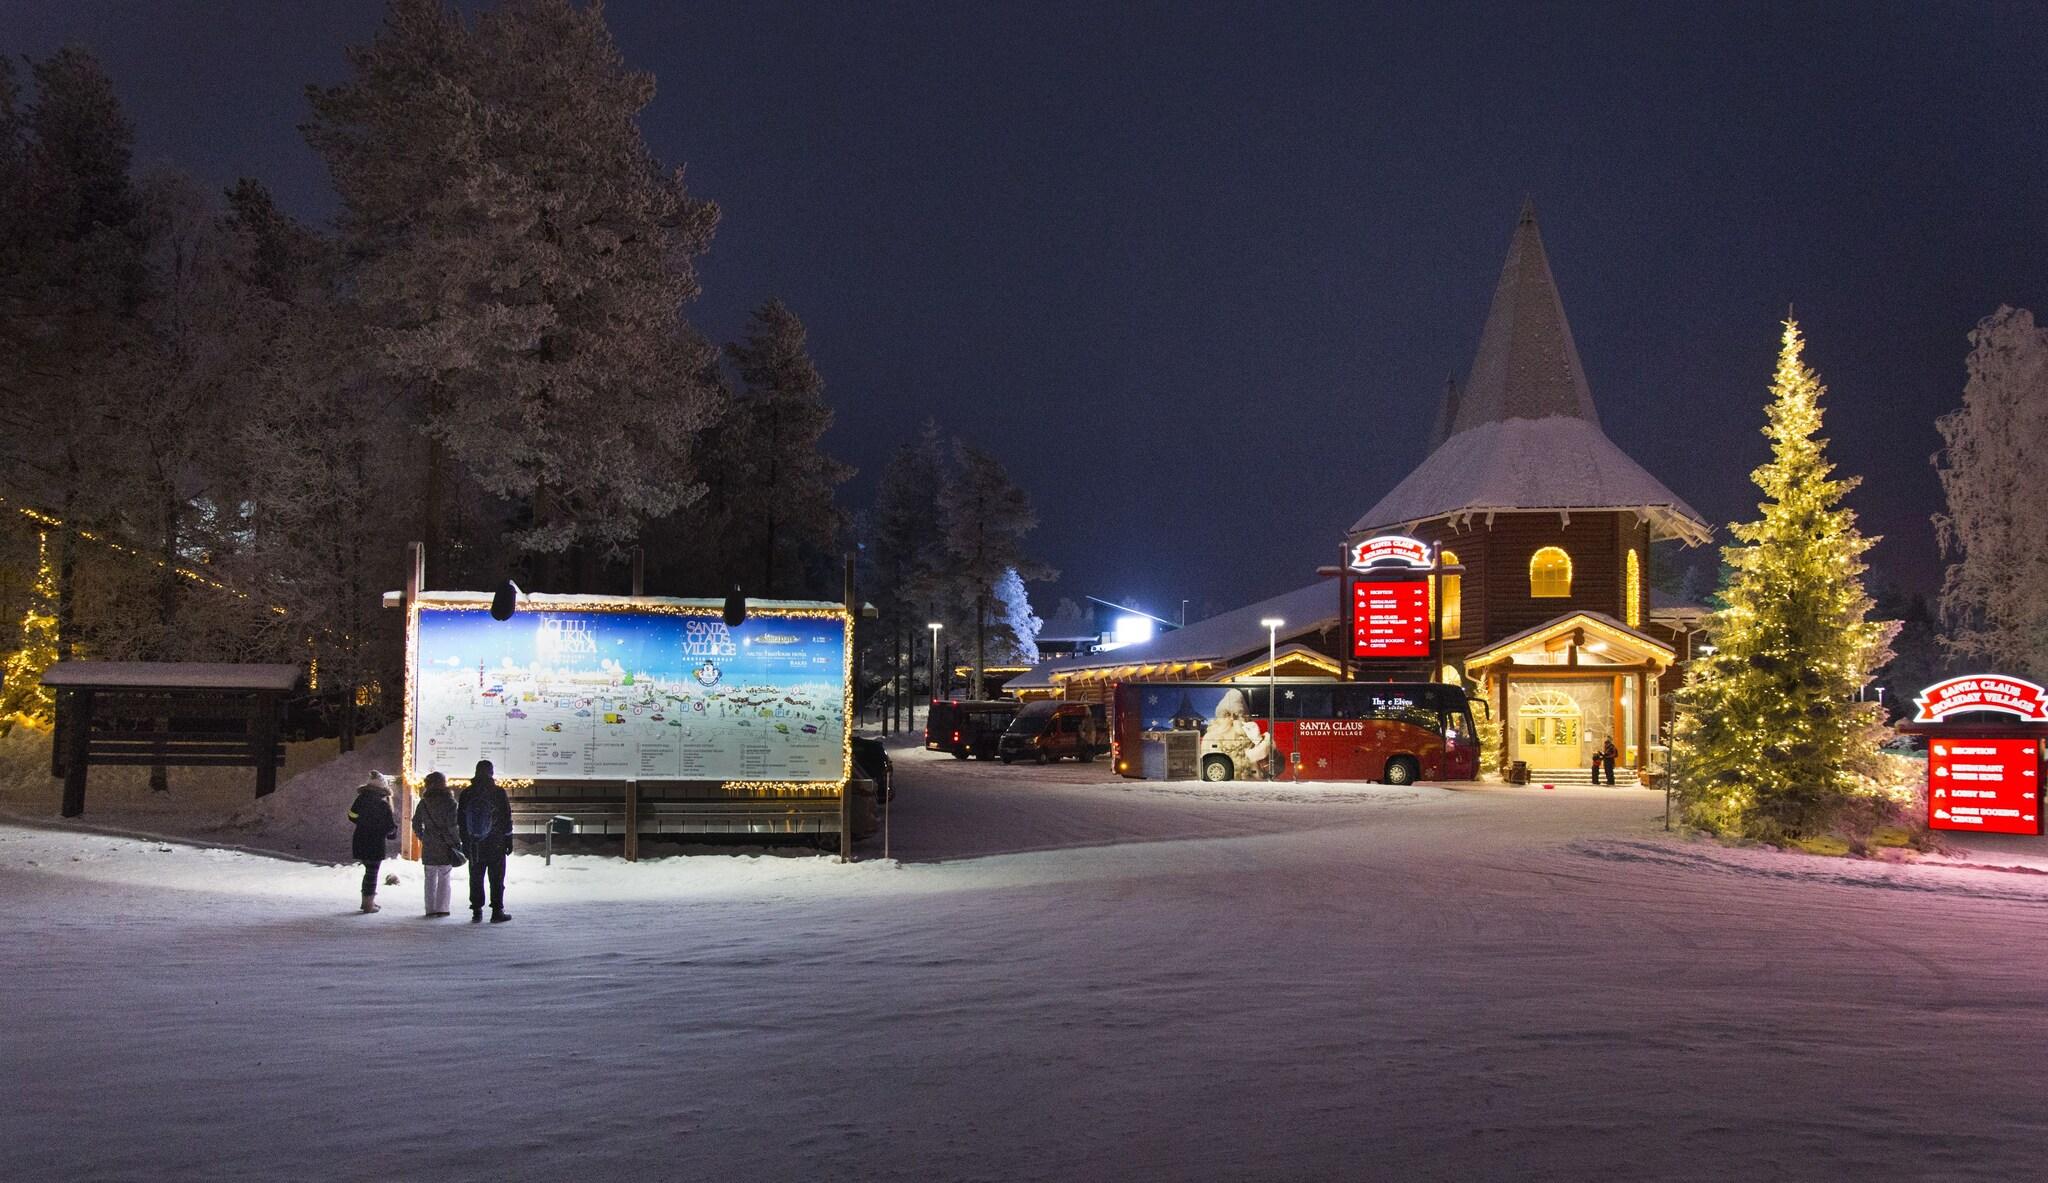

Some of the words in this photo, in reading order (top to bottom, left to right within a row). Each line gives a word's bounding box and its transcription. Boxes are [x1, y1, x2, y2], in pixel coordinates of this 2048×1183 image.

[1370, 540, 1392, 550] SANTA
[1393, 540, 1414, 549] CLAUS
[686, 621, 730, 636] SANTA
[687, 633, 730, 645] CLAUS
[1940, 681, 1979, 699] SANTA
[1980, 680, 2021, 697] CLAUS
[1372, 697, 1393, 705] Thre
[1930, 693, 1982, 715] HOLIDAY
[1984, 693, 2036, 713] VILLAGE
[1300, 722, 1331, 730] SANTA
[1332, 722, 1364, 730] CLAUS
